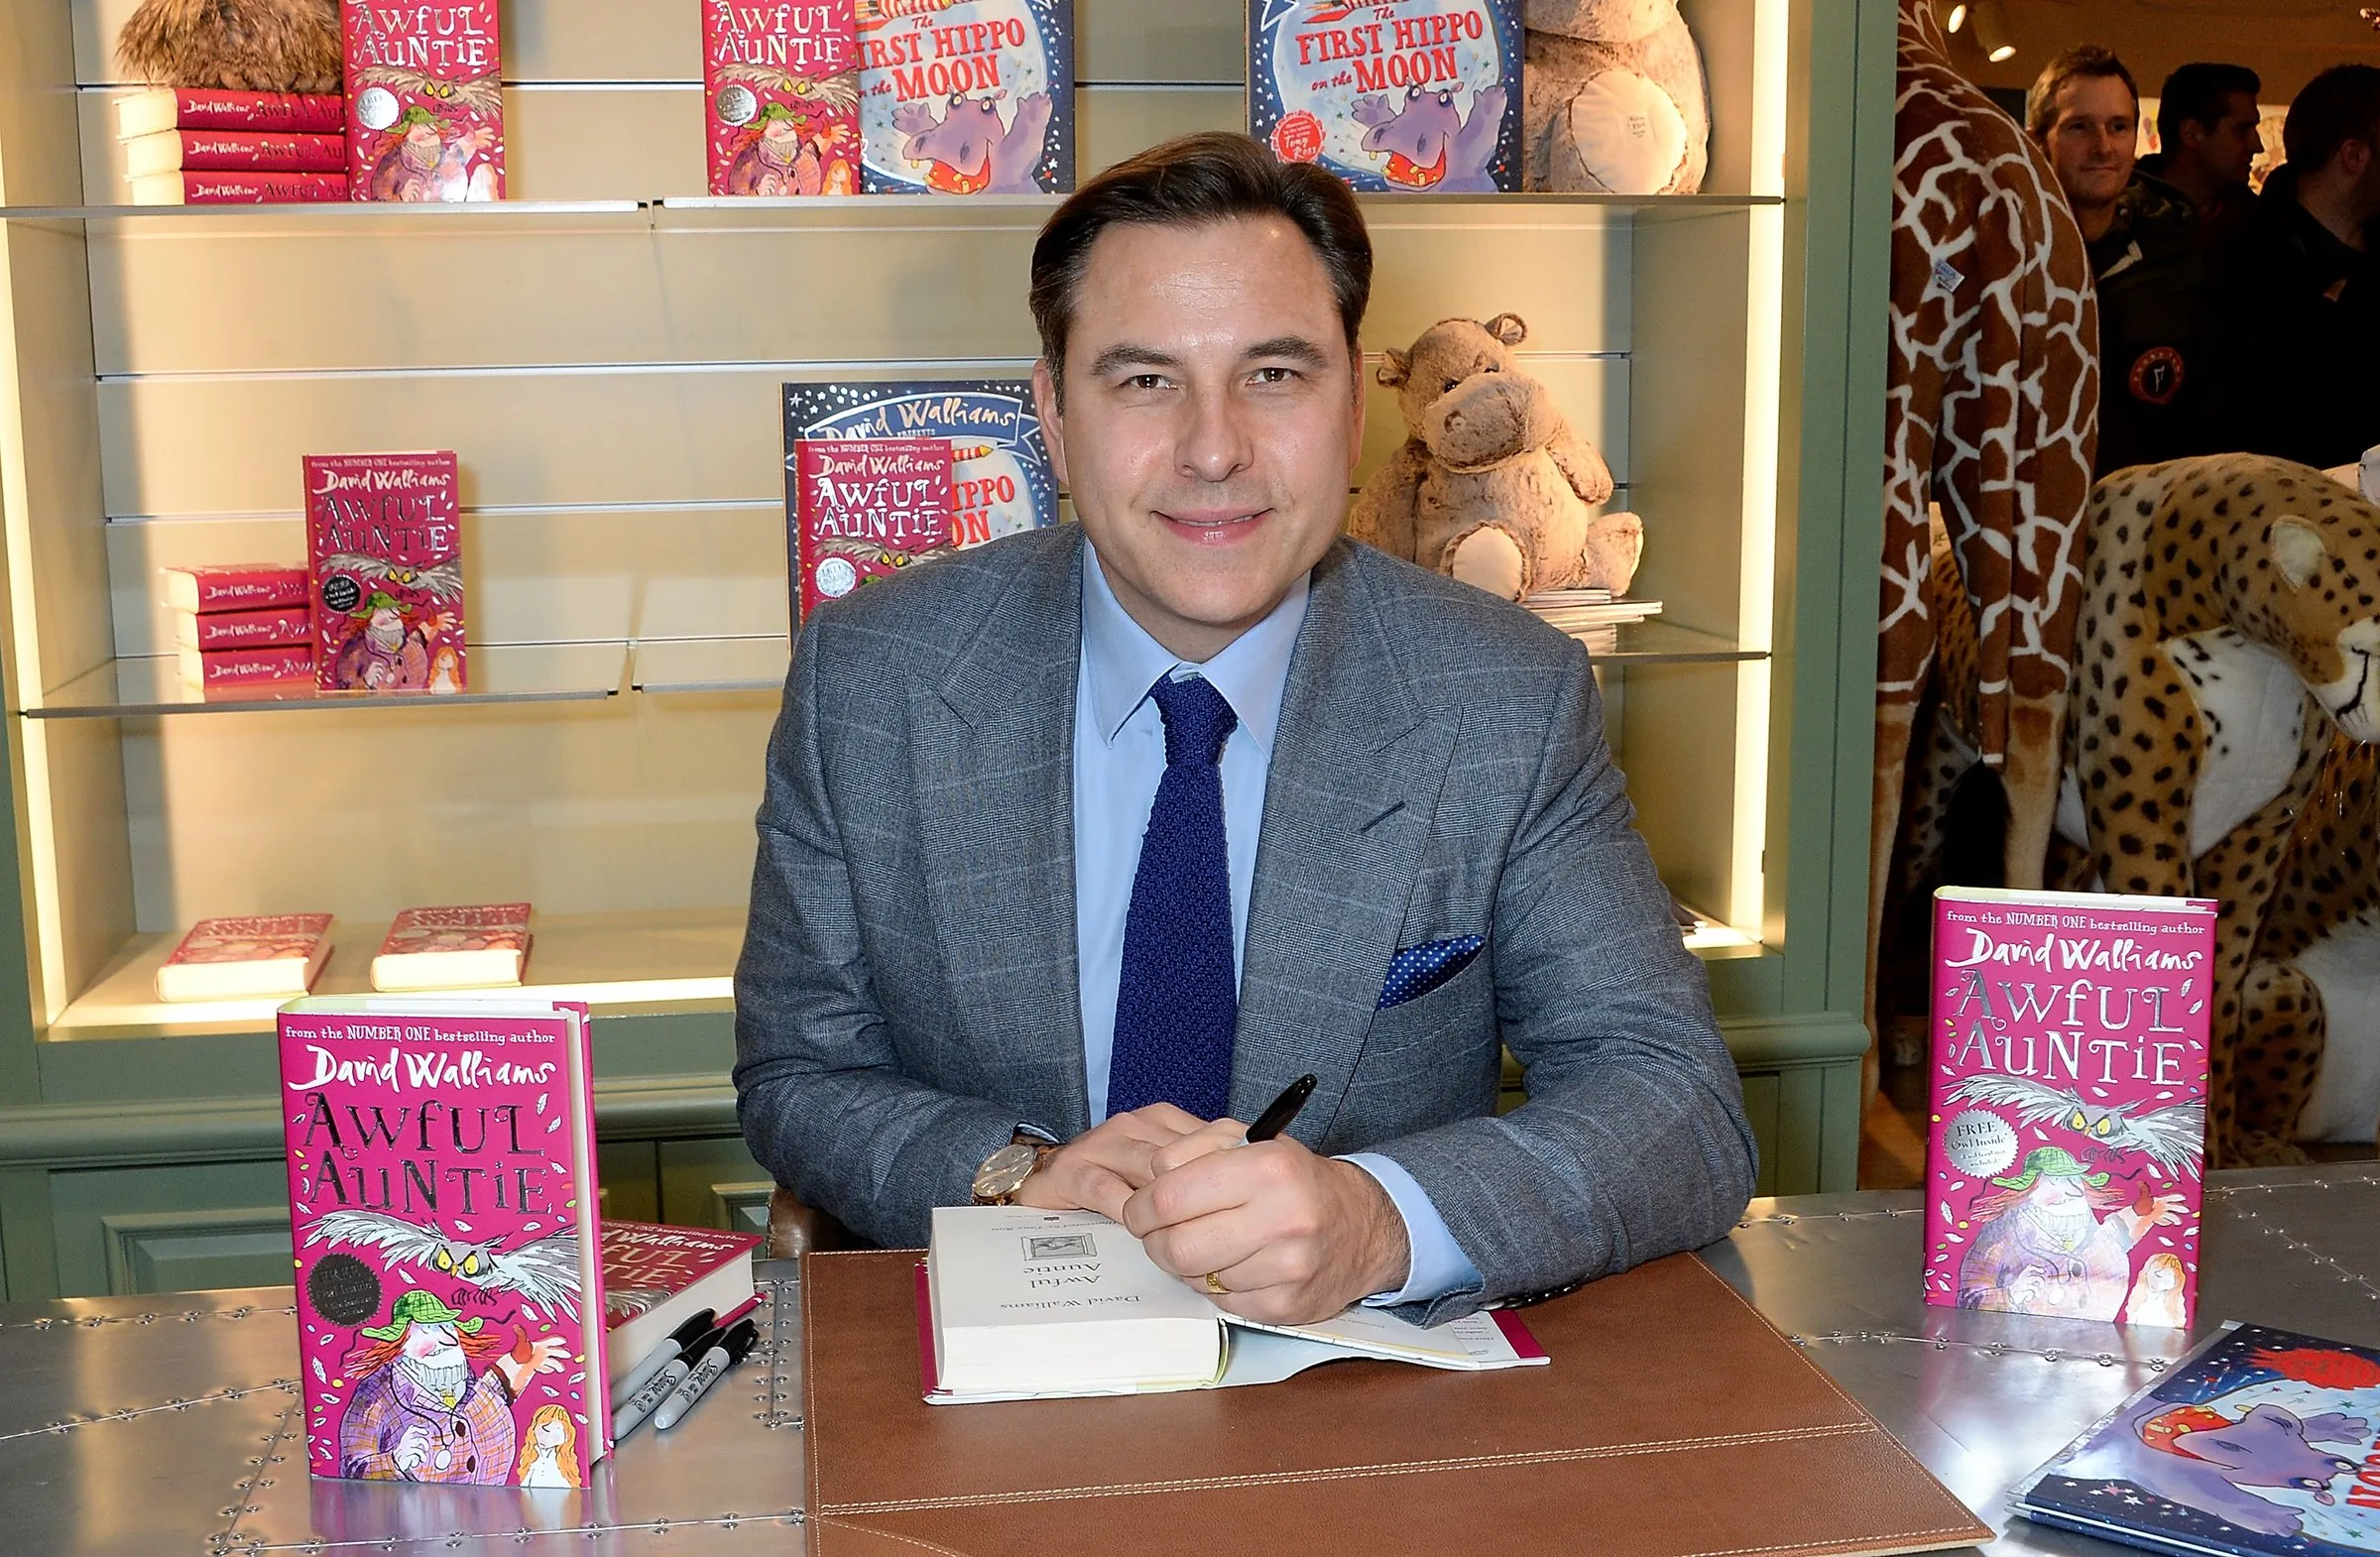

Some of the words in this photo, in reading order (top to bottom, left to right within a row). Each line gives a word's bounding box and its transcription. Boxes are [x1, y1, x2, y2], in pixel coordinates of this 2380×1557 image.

[911, 15, 933, 30] The
[1373, 6, 1395, 21] The
[855, 32, 923, 71] IRST
[931, 18, 1025, 59] HIPPO
[1295, 23, 1383, 65] FIRST
[1391, 10, 1484, 51] HIPPO
[871, 78, 892, 96] the
[892, 54, 1001, 102] MOON
[1311, 79, 1328, 91] on
[1331, 70, 1353, 87] the
[1353, 46, 1458, 94] MOON
[896, 397, 1016, 428] Walliams
[808, 454, 868, 479] David
[869, 454, 945, 475] Walliams
[311, 468, 372, 495] David
[373, 468, 451, 490] Walliams
[952, 474, 1015, 512] IPPO
[952, 509, 992, 547] ON
[1947, 910, 1977, 923] from
[1980, 910, 2002, 925] the
[2005, 911, 2059, 929] NUMBER
[2062, 915, 2086, 929] ONE
[2089, 917, 2157, 936] bestselling
[2161, 920, 2205, 935] author
[1945, 927, 2056, 974] David
[2058, 937, 2203, 973] Walliams
[286, 1025, 317, 1039] from
[320, 1025, 344, 1039] the
[346, 1024, 402, 1042] NUMBER
[405, 1026, 430, 1041] ONE
[434, 1028, 506, 1046] bestselling
[510, 1029, 555, 1043] author
[288, 1044, 400, 1093] David
[403, 1050, 557, 1089] Walliams
[1957, 1121, 1998, 1138] FREE
[1951, 1138, 1973, 1150] Owl
[617, 1231, 735, 1251] Walliams
[712, 1233, 748, 1242] author
[602, 1244, 691, 1268] fUL
[1023, 1262, 1102, 1276] Auntie
[1030, 1274, 1102, 1289] Awful
[1000, 1298, 1081, 1309] Walliams
[1087, 1294, 1141, 1306] David
